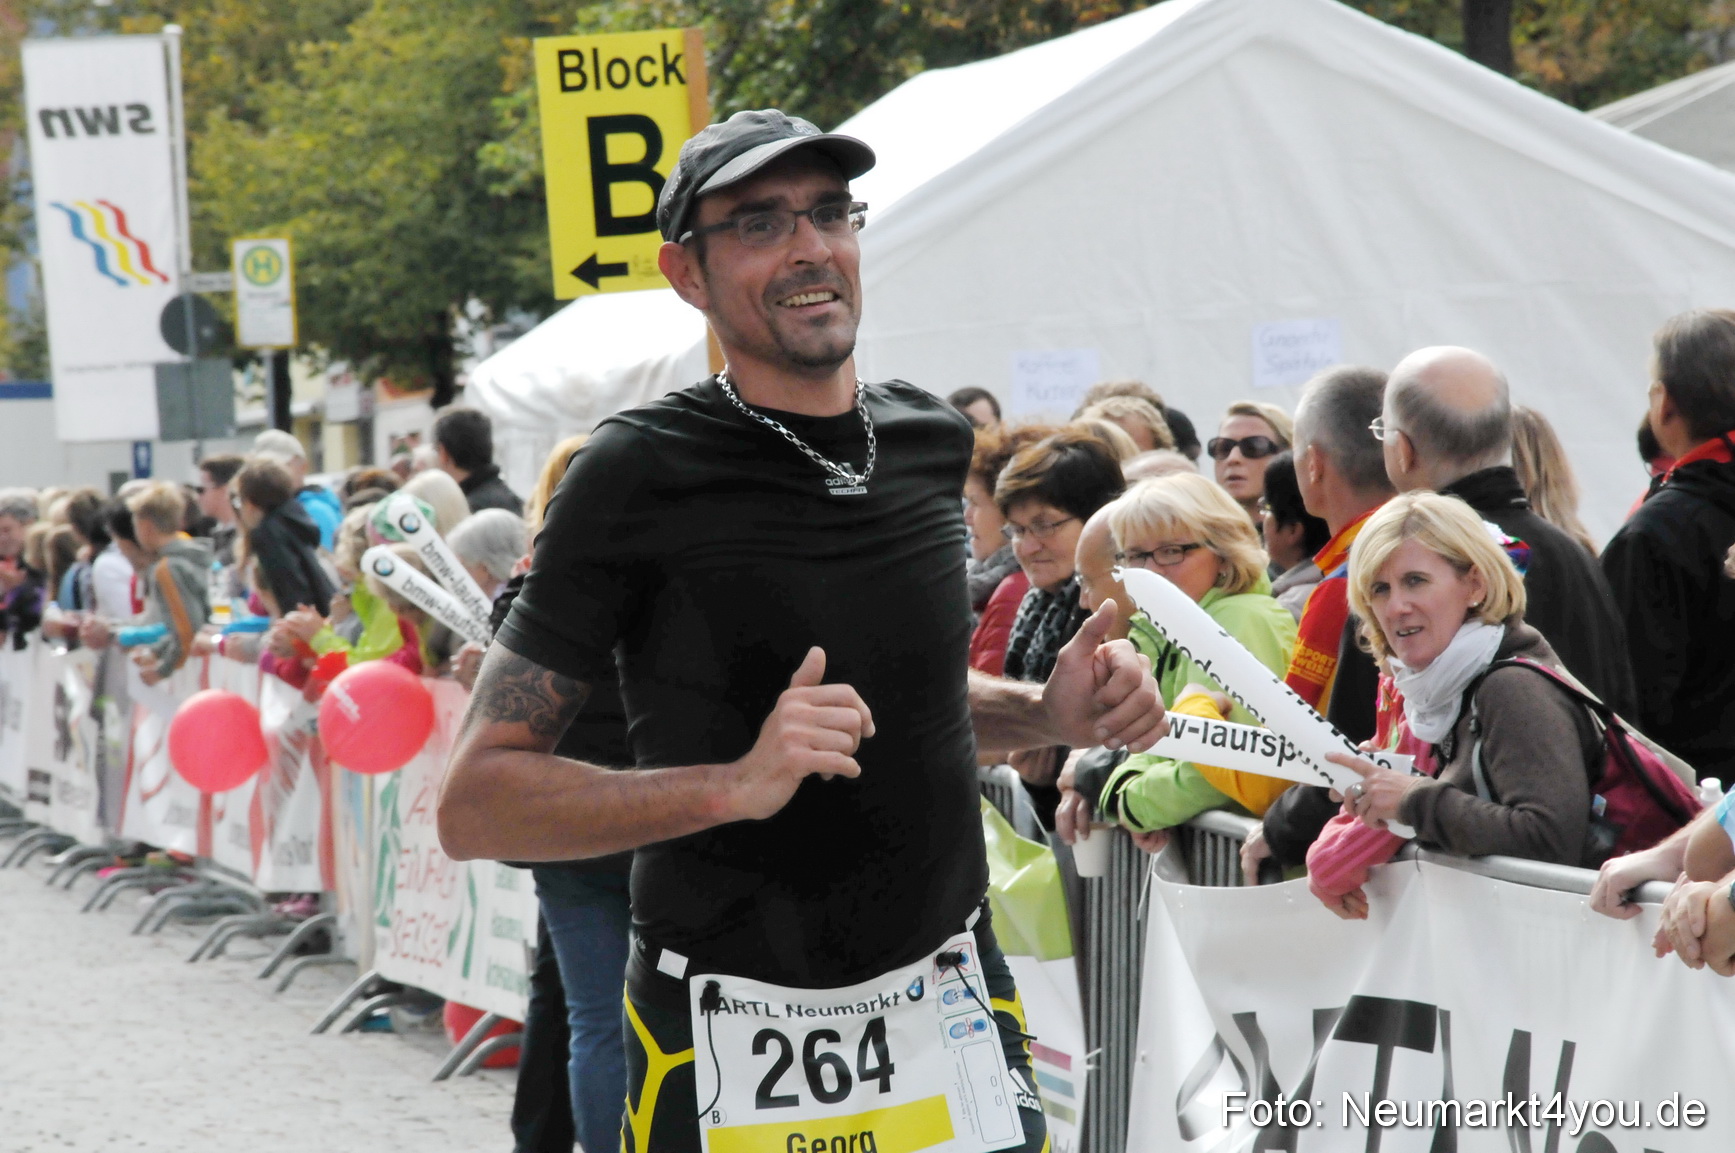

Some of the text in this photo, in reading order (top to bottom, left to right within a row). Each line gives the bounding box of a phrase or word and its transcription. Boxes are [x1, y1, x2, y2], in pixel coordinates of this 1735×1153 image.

[558, 43, 686, 92] Block
[587, 114, 667, 237] B
[786, 992, 901, 1018] Neumarkt
[751, 1015, 896, 1111] 264
[711, 1109, 722, 1125] B
